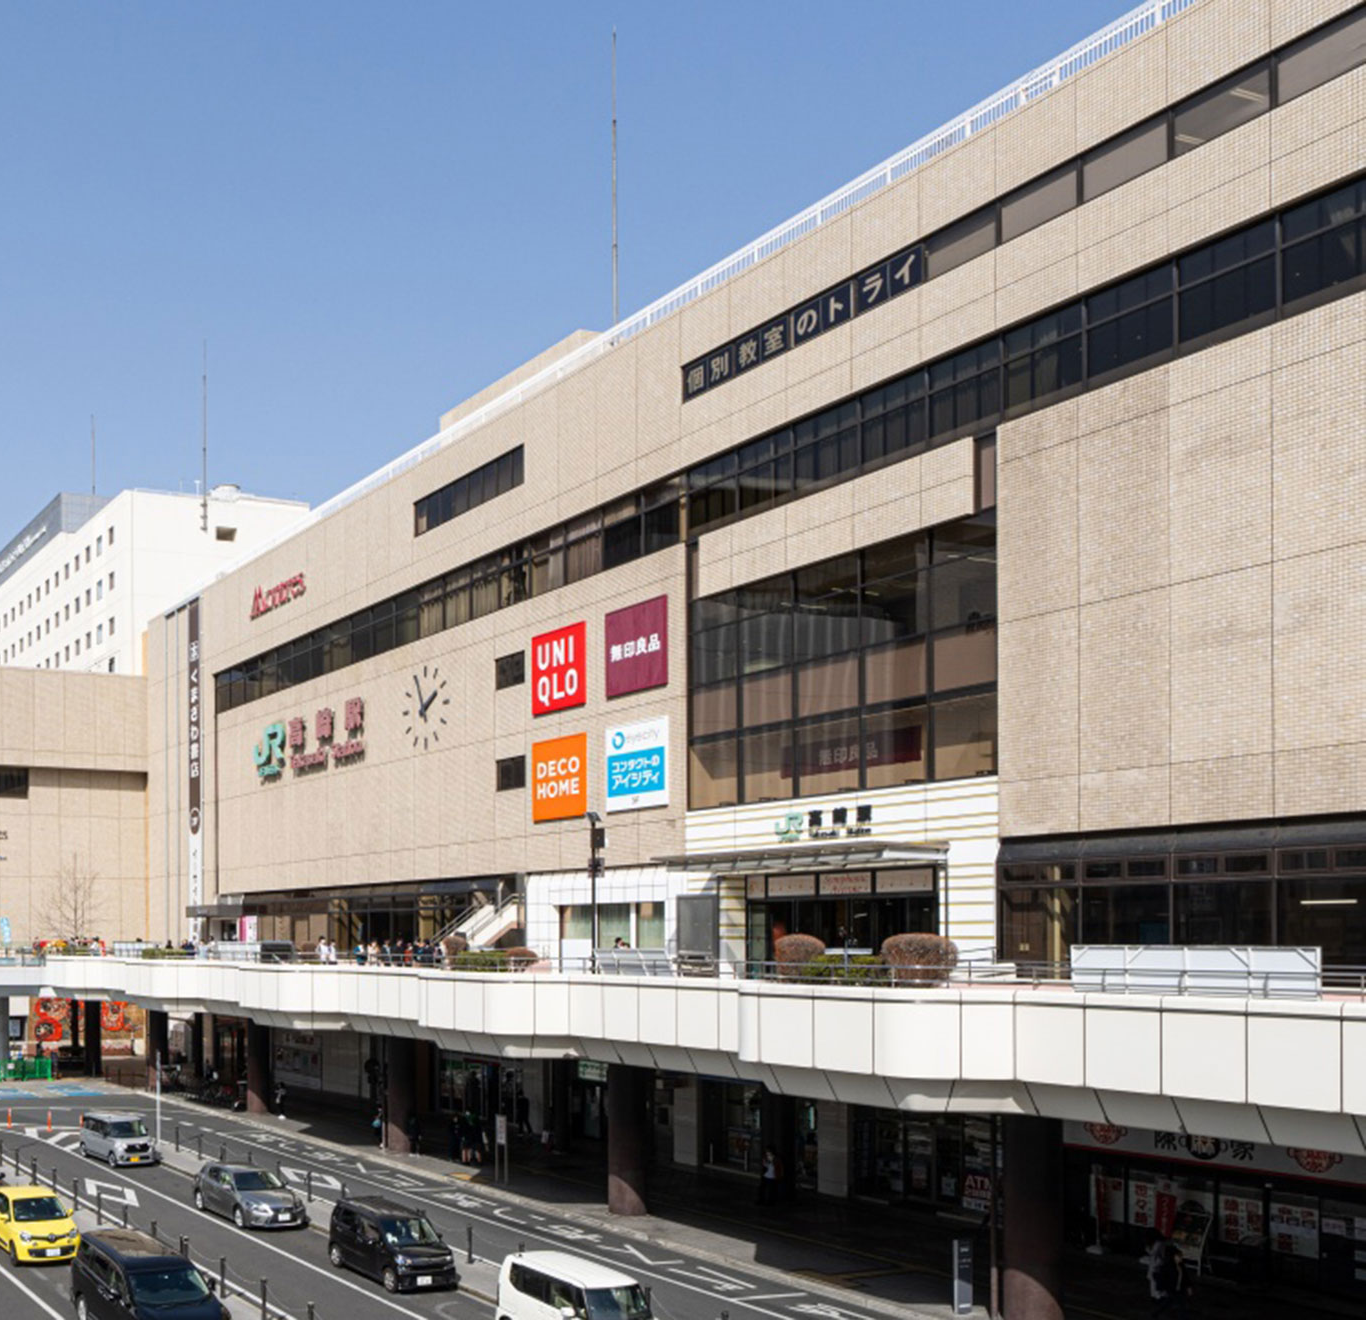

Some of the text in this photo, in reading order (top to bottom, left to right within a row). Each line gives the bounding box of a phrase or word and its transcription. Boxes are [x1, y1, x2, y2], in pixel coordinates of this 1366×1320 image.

[687, 253, 916, 395] 個別教室のトライ
[537, 635, 574, 671] UNI
[610, 632, 661, 663] 無印良品
[537, 668, 578, 707] QLO
[253, 697, 363, 766] JR 高崎駅
[536, 756, 580, 780] DECO
[611, 754, 661, 773] コンタクトの
[536, 777, 580, 800] HOME
[611, 769, 661, 791] アイシティ
